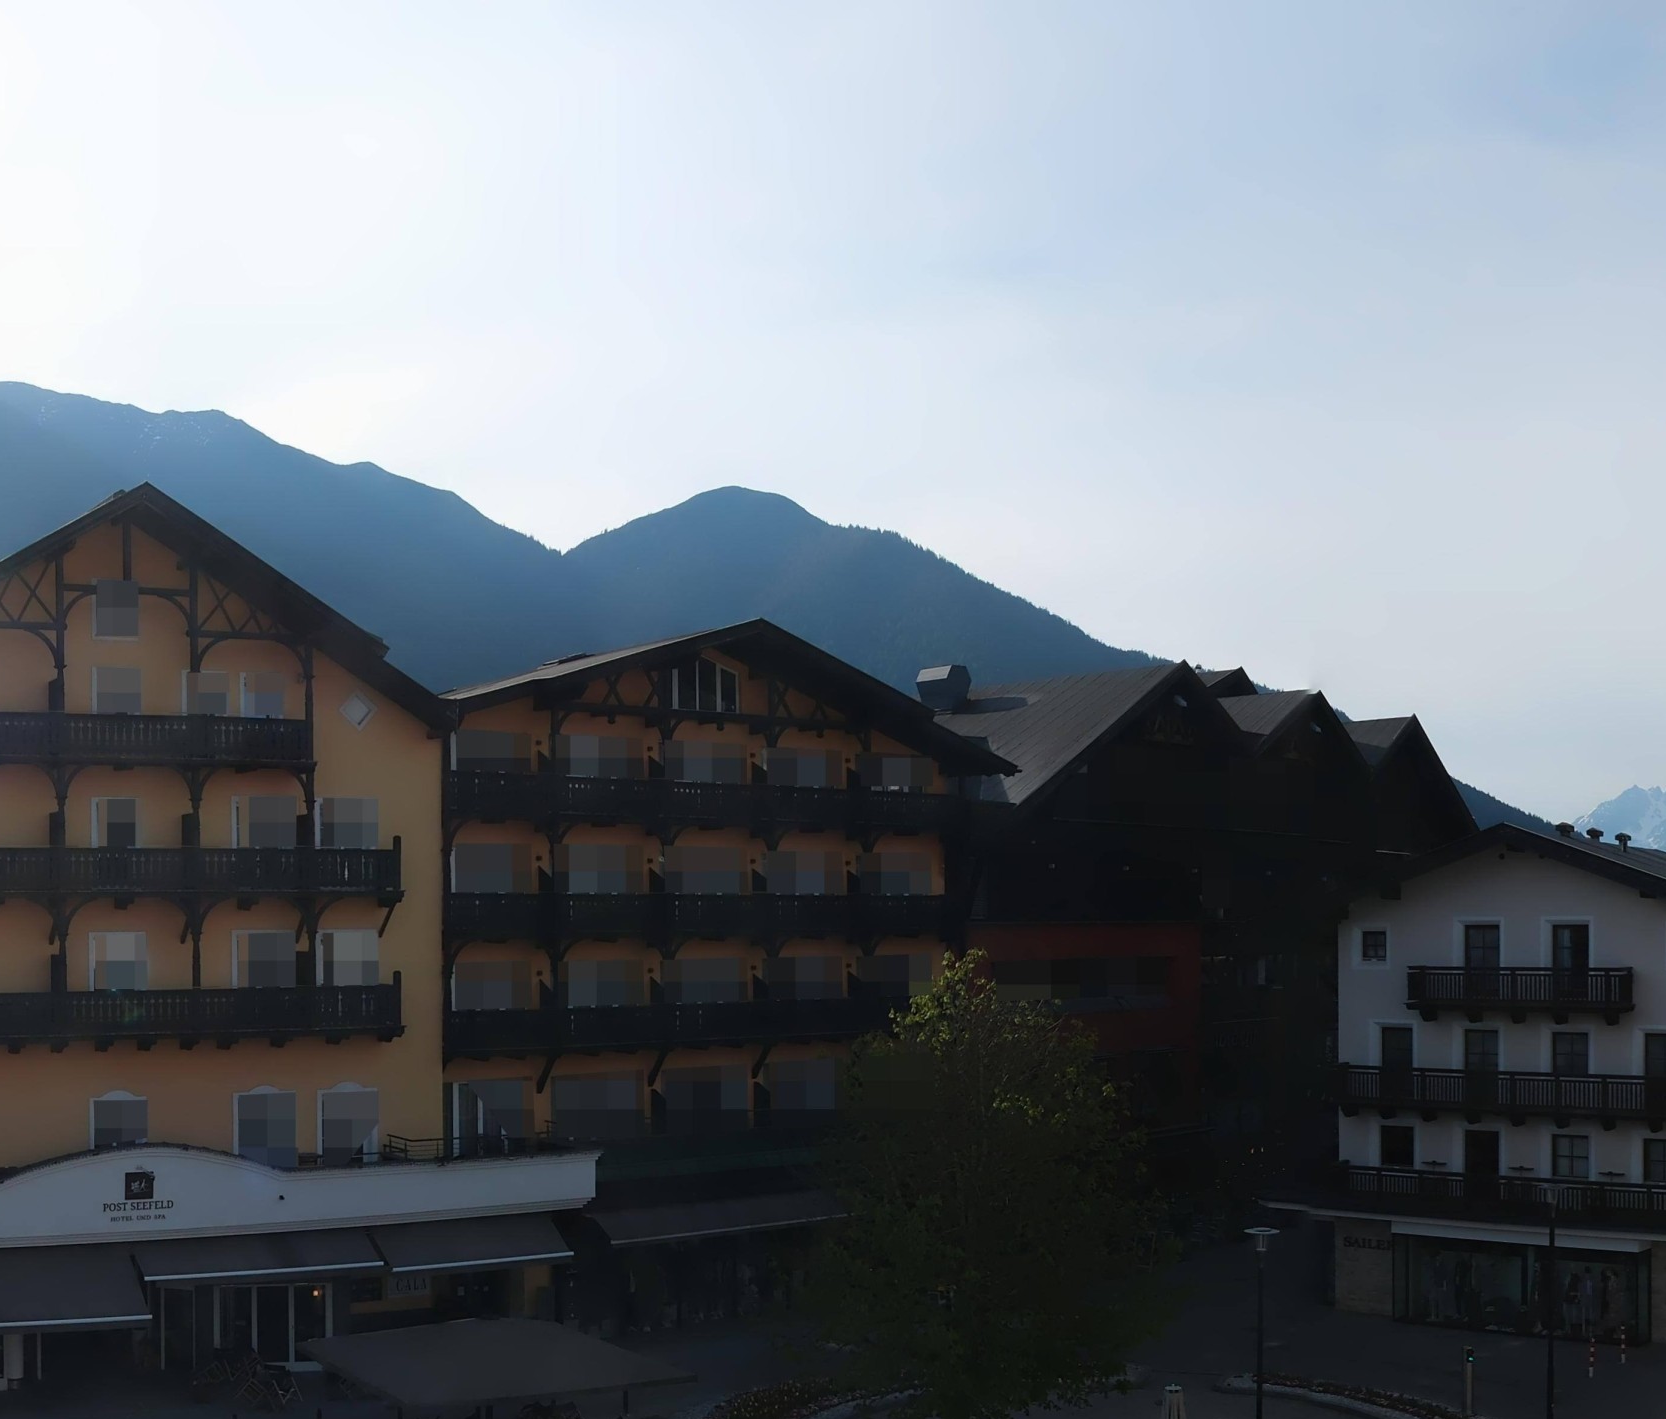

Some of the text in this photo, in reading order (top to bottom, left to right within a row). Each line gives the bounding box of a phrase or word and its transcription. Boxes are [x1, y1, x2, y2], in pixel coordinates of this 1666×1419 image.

[103, 1200, 174, 1213] POST SEEFELD
[110, 1215, 134, 1223] HOTEL
